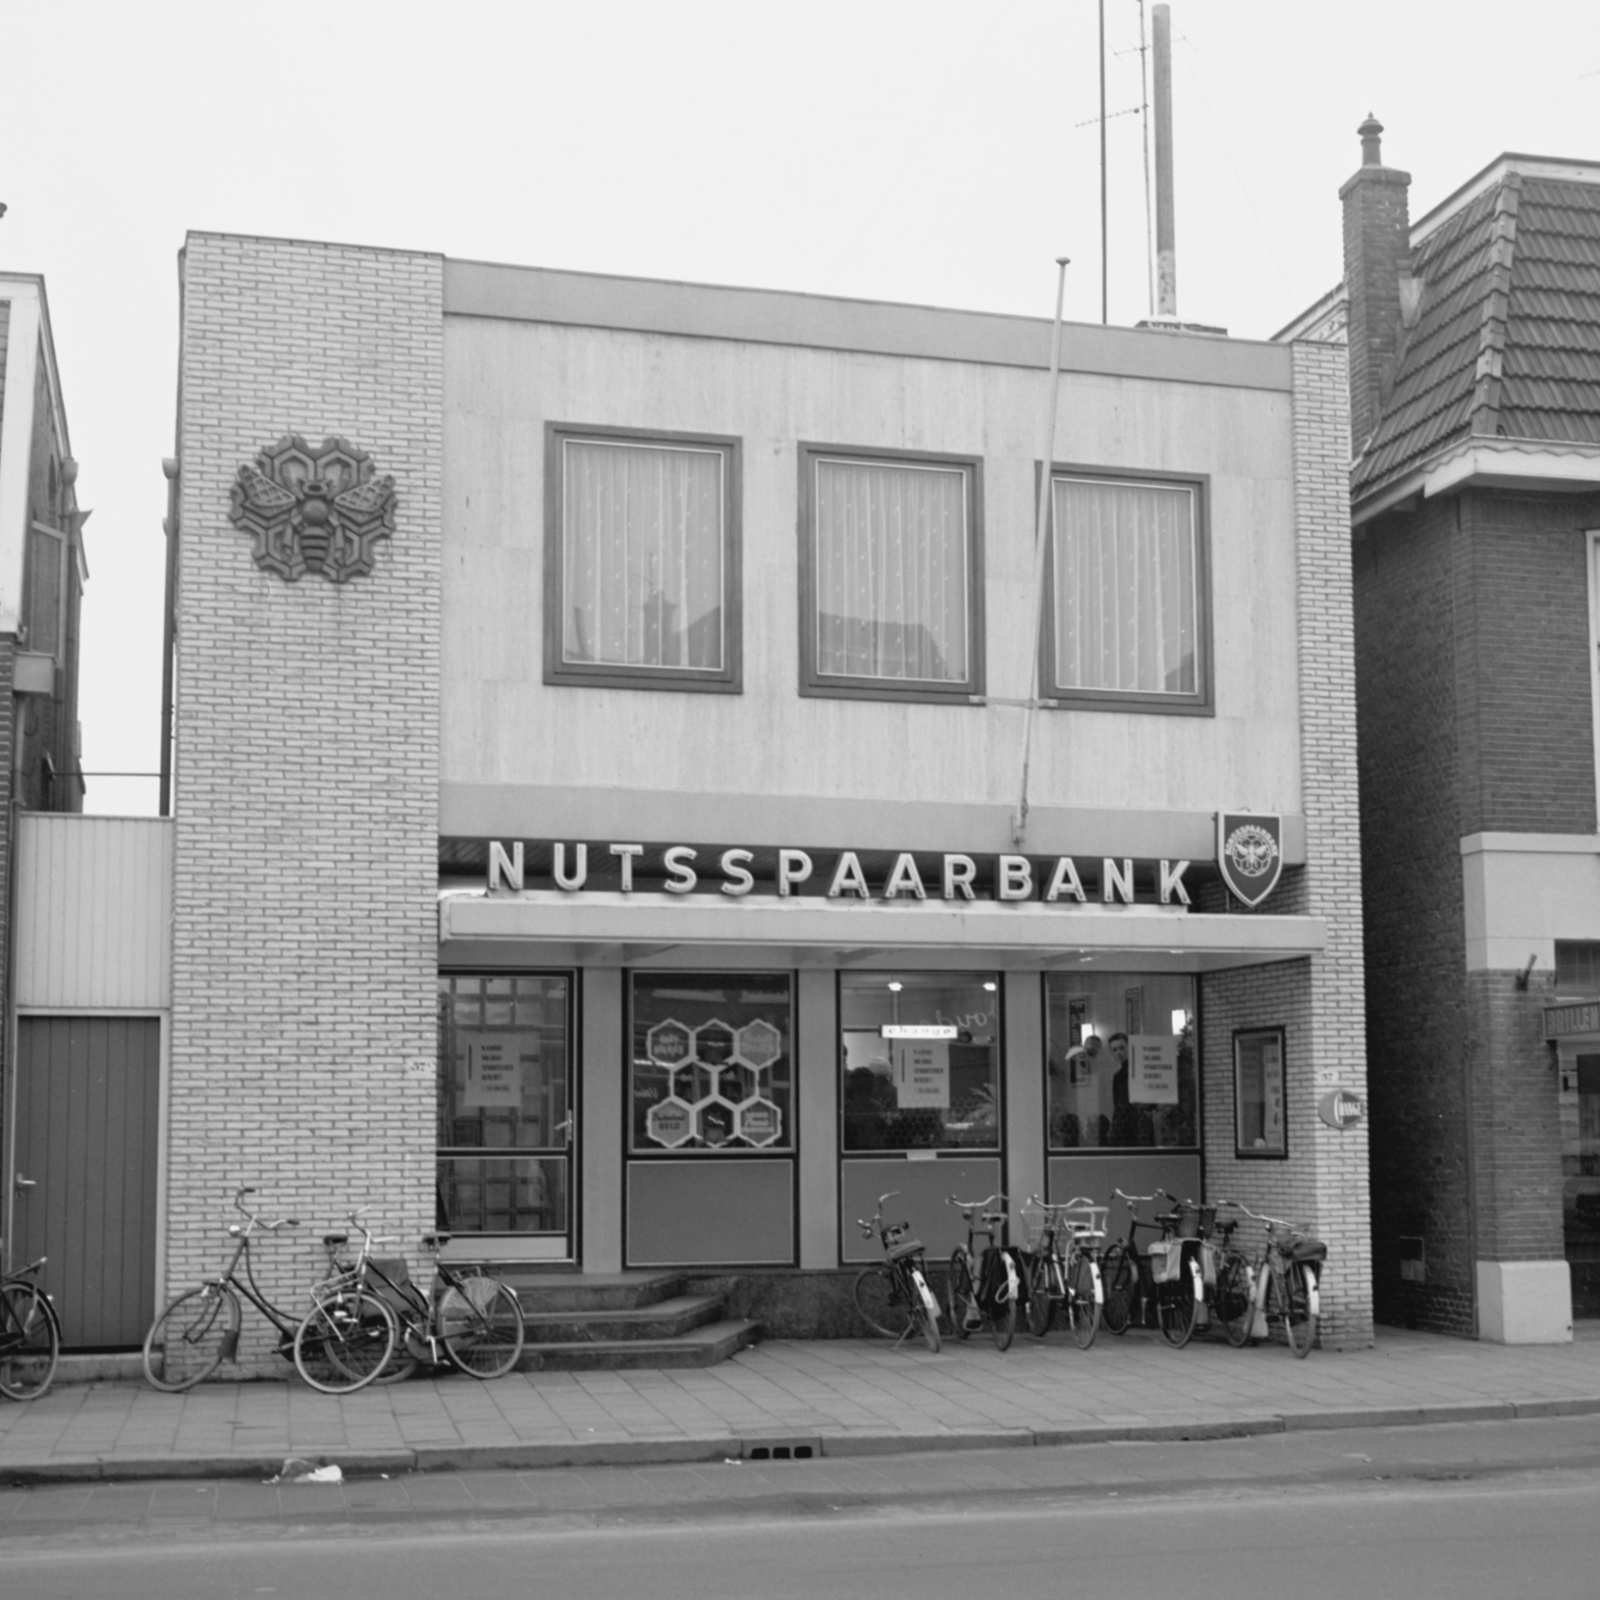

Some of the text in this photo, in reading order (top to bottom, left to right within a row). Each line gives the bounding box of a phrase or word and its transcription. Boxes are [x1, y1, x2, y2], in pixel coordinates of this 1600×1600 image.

[488, 840, 1191, 905] NUTSSPAARBANK
[888, 1026, 951, 1036] change
[1546, 1005, 1599, 1035] BRILLEN
